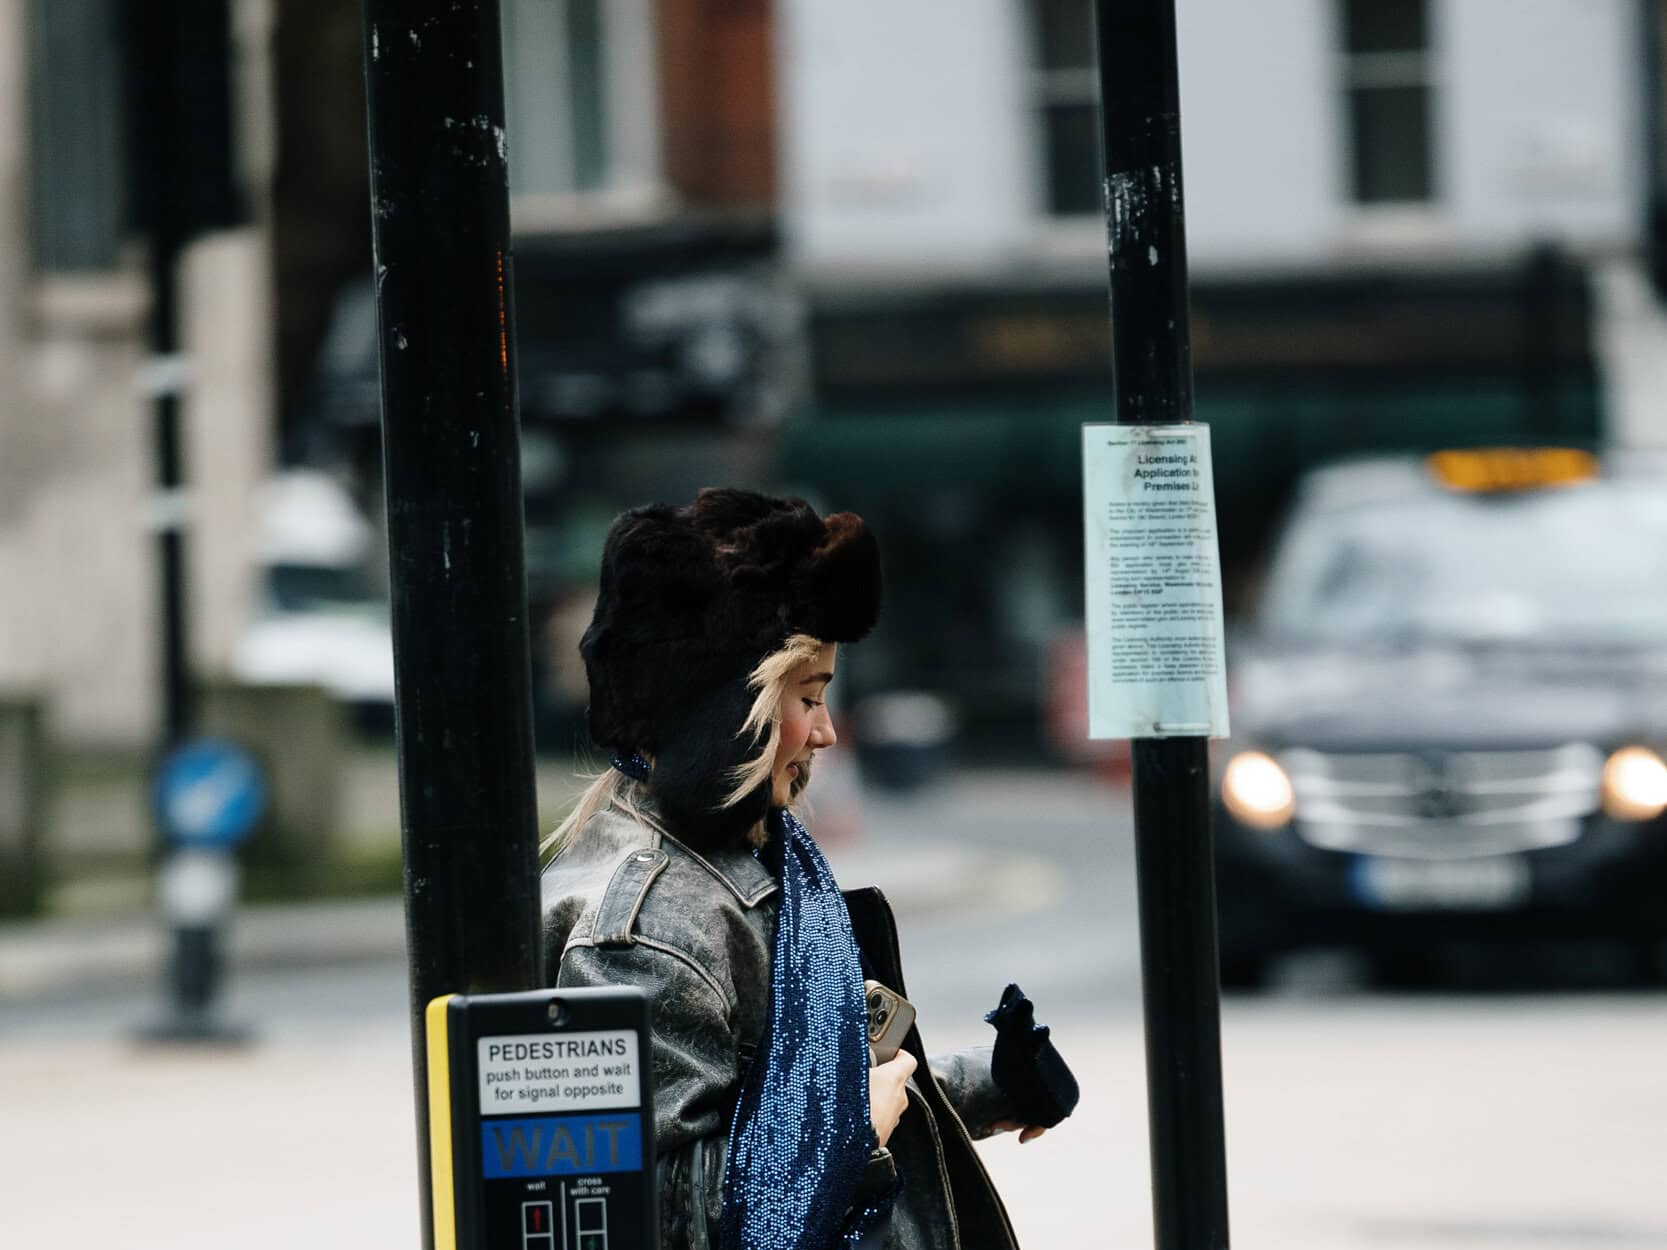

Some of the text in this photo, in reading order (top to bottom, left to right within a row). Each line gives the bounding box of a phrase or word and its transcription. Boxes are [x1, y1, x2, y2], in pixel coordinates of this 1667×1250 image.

[1138, 455, 1187, 465] Licensing
[1134, 468, 1190, 480] Application
[1144, 482, 1190, 491] Premises
[489, 1038, 627, 1062] PEDESTRIANS
[486, 1063, 631, 1085] push button and wait
[495, 1082, 624, 1102] for signal opposite
[493, 1121, 629, 1171] WAIT
[527, 1181, 546, 1191] wait
[577, 1177, 602, 1186] cross
